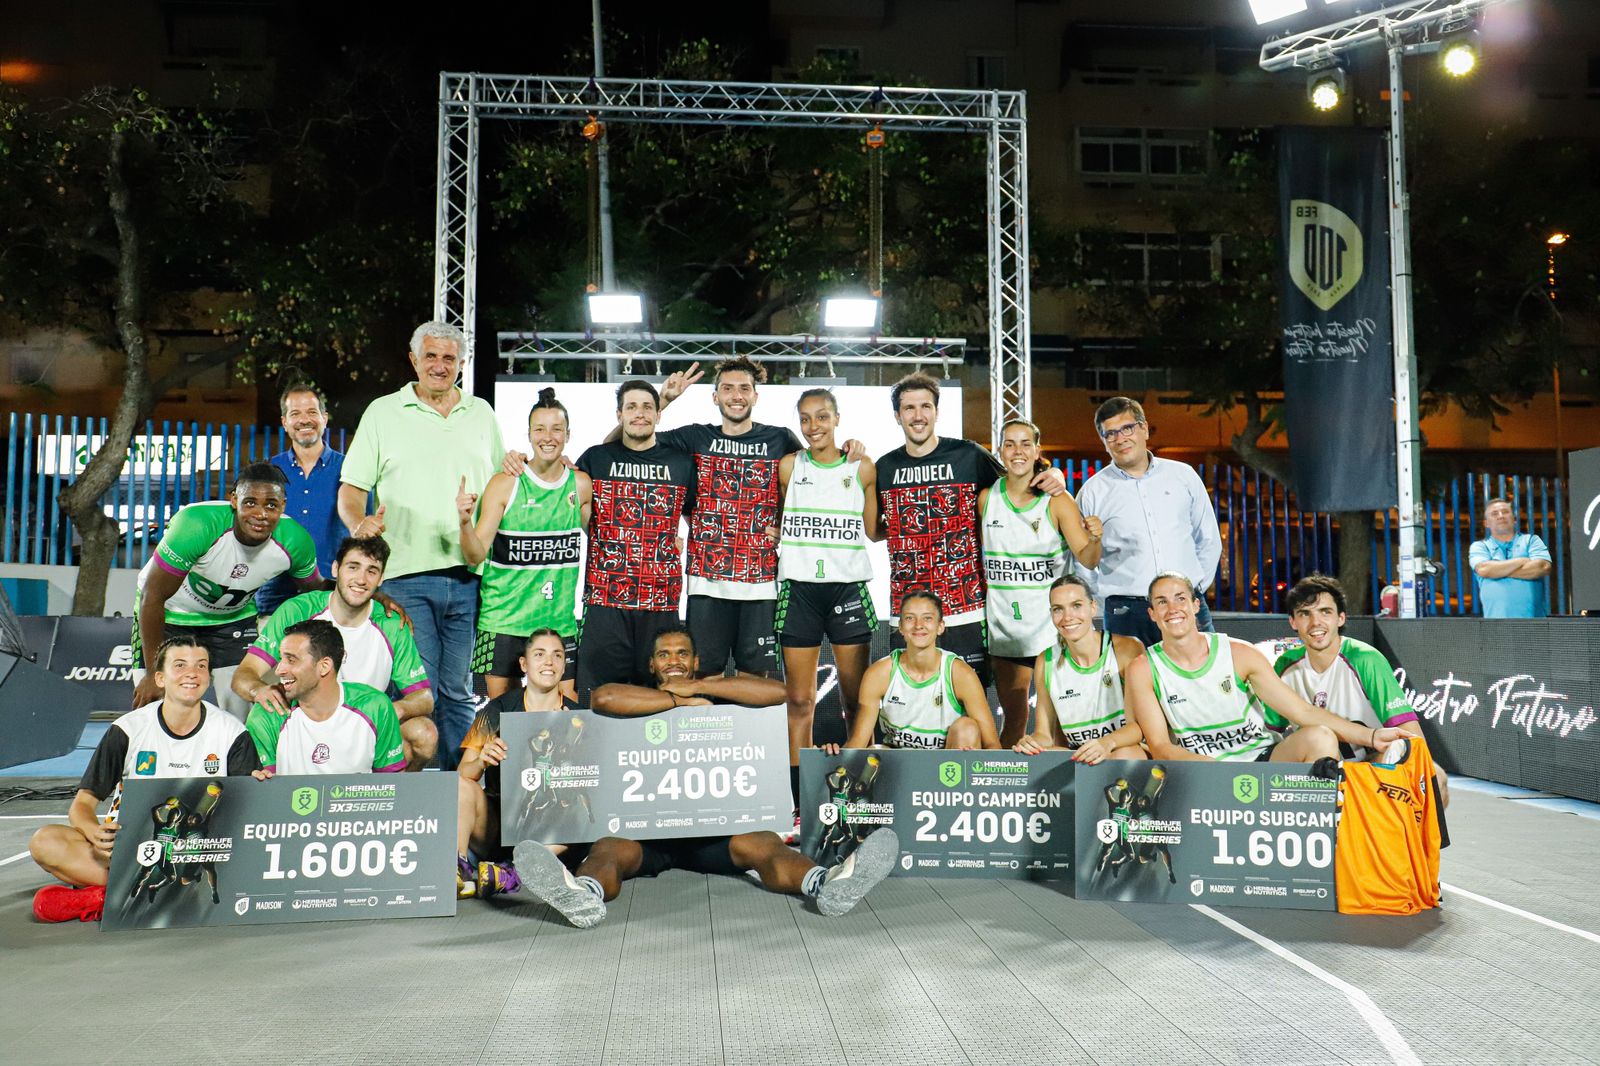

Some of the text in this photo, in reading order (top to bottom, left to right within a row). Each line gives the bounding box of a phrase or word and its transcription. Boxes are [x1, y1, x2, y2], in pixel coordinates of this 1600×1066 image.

[709, 439, 767, 456] AZUQUECA
[609, 461, 671, 481] AZUQUECA
[893, 463, 954, 484] AZUQUECA
[783, 516, 862, 530] HERBALIFE
[782, 527, 860, 541] NUTRITION
[509, 536, 581, 551] HERBALFE
[508, 547, 581, 562] NUTRITON
[816, 559, 825, 578] 1
[541, 582, 554, 600] 4
[1011, 602, 1022, 620] 1
[64, 667, 117, 680] JOHN
[1487, 675, 1598, 738] Futuro
[677, 732, 734, 742] 3X3SERIES
[618, 742, 766, 768] EQUIPO CAMPEÓN
[550, 780, 599, 788] 3X3SERIES
[622, 765, 757, 802] 2.400€
[971, 776, 1028, 786] 3X3SERIES
[1284, 781, 1336, 789] NUTRITION
[344, 790, 396, 798] NUTRITION
[912, 789, 1061, 809] EQUIPO CAMPEÓN
[1270, 792, 1336, 803] 3X3SERIES
[328, 802, 395, 812] 3X3SERIES
[625, 820, 648, 828] MADISON
[1190, 809, 1333, 828] EQUIPO SUBCAM
[243, 815, 439, 842] EQUIPO SUBCAMPEÓN
[915, 810, 1051, 844] 2.400€
[1127, 835, 1182, 844] 3X3SERIES
[1212, 829, 1332, 869] 1.600
[170, 853, 231, 863] 3X3SERIES
[262, 839, 418, 880] 1.600€
[918, 859, 940, 867] MADISON
[1209, 884, 1234, 894] MADISON
[256, 901, 282, 910] MADISON
